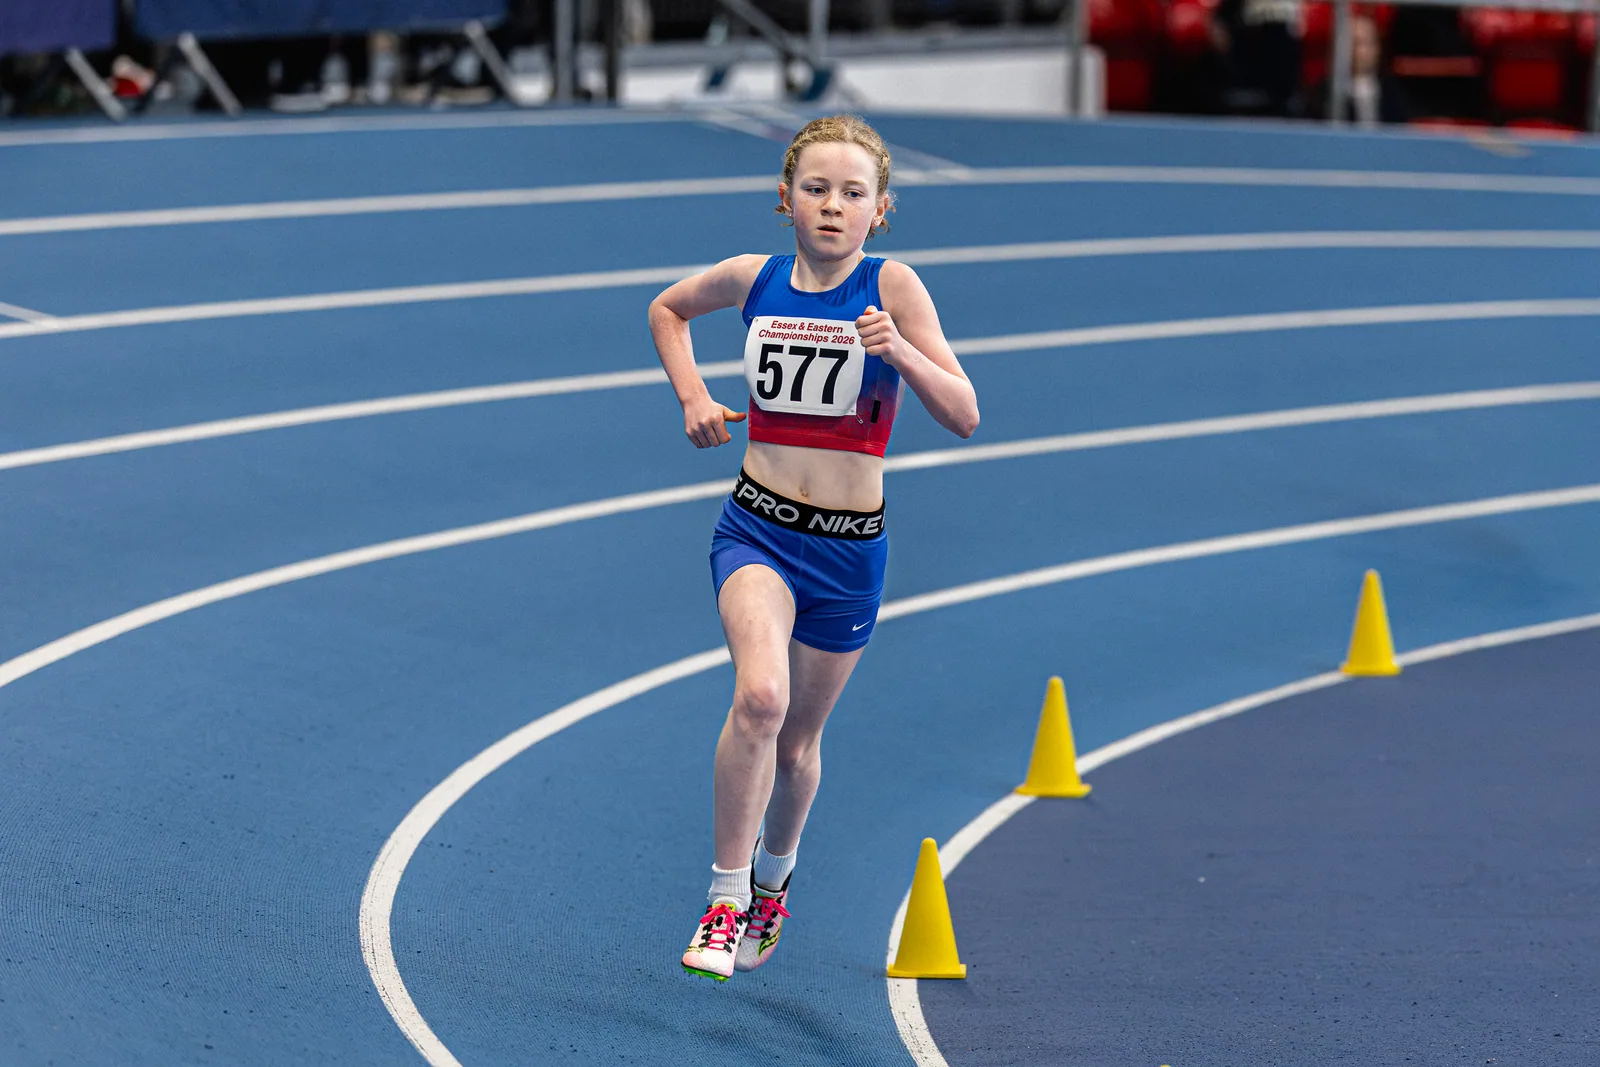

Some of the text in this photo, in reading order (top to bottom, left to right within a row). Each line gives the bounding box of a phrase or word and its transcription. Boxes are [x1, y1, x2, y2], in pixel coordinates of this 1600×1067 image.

[758, 329, 855, 345] Championships 2026
[771, 320, 844, 333] Essex & Eastern
[756, 343, 849, 404] 577
[737, 482, 800, 523] PRO
[807, 512, 882, 535] NIKE
